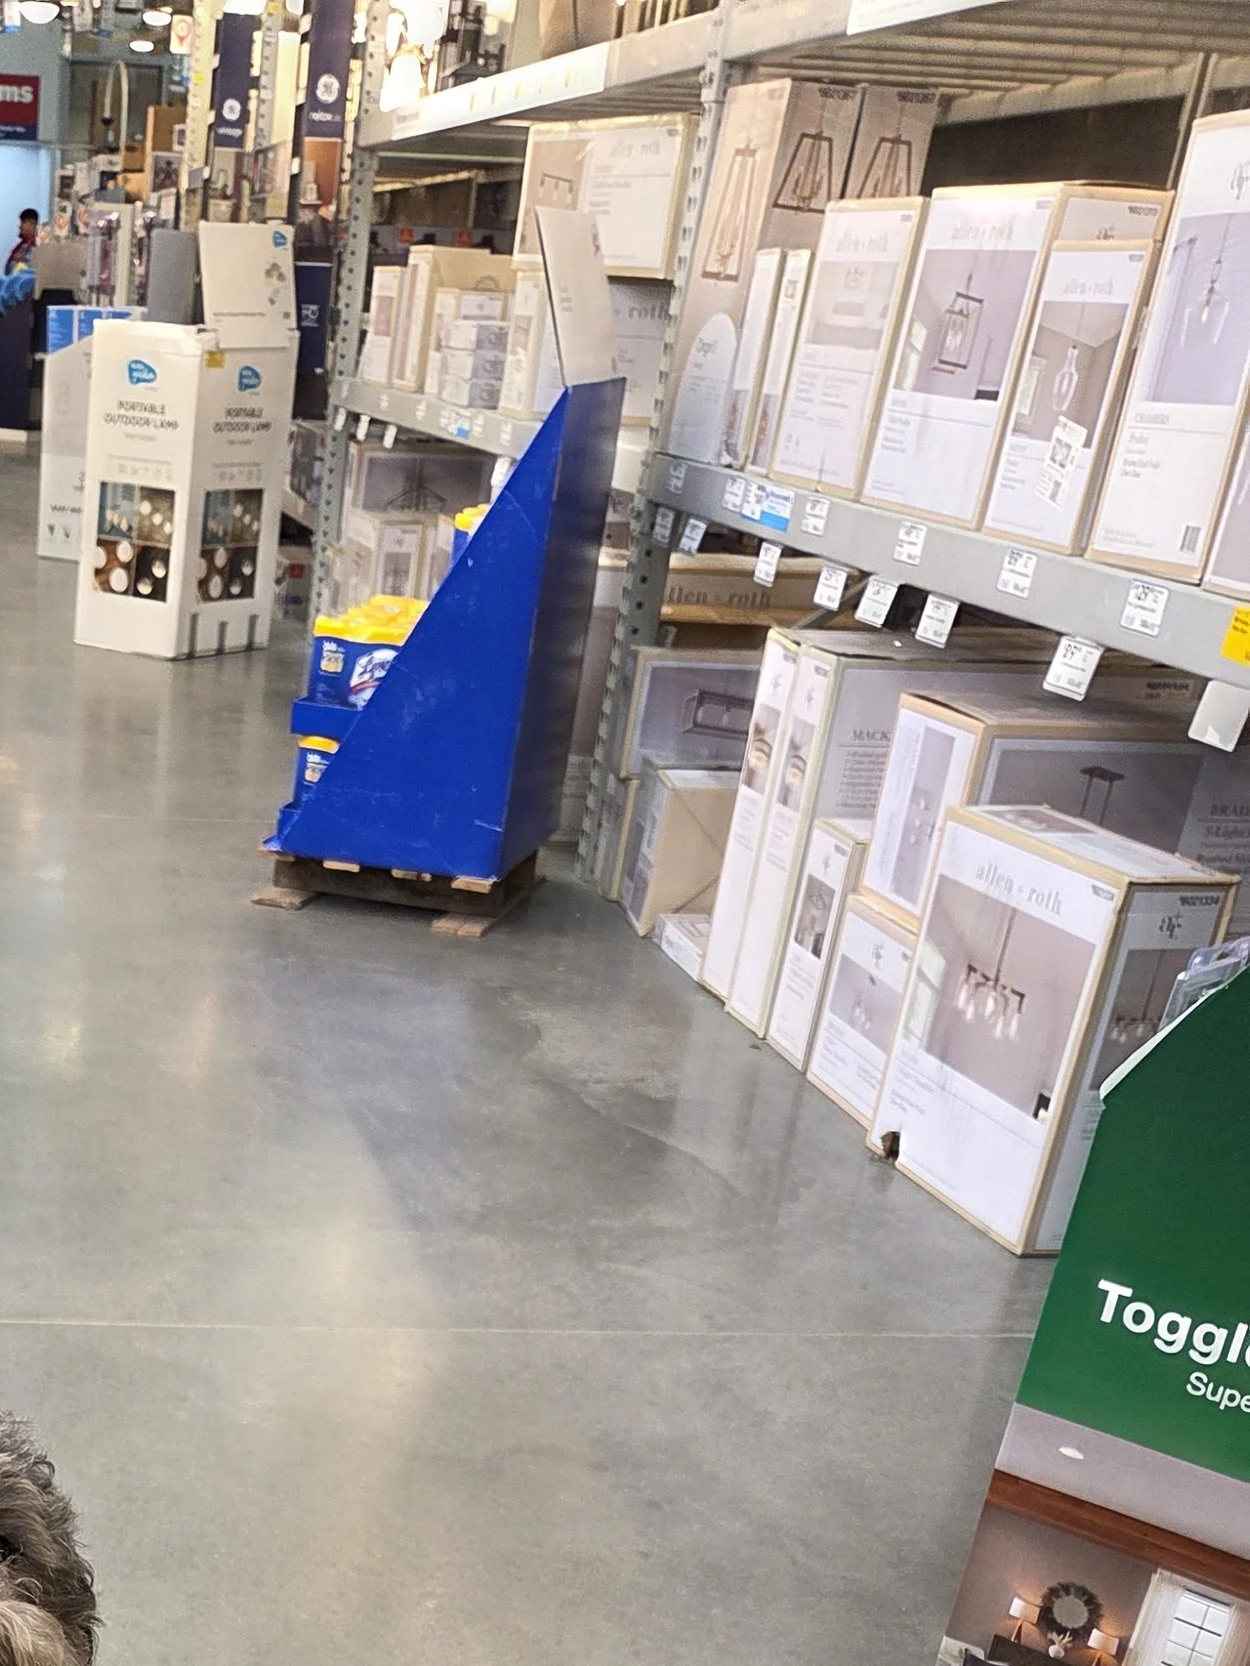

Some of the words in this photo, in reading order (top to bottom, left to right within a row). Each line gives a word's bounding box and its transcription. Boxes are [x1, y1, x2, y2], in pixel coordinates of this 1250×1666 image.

[975, 860, 1015, 894] allen
[1027, 886, 1062, 915] roth
[1098, 1279, 1250, 1369] Toggl
